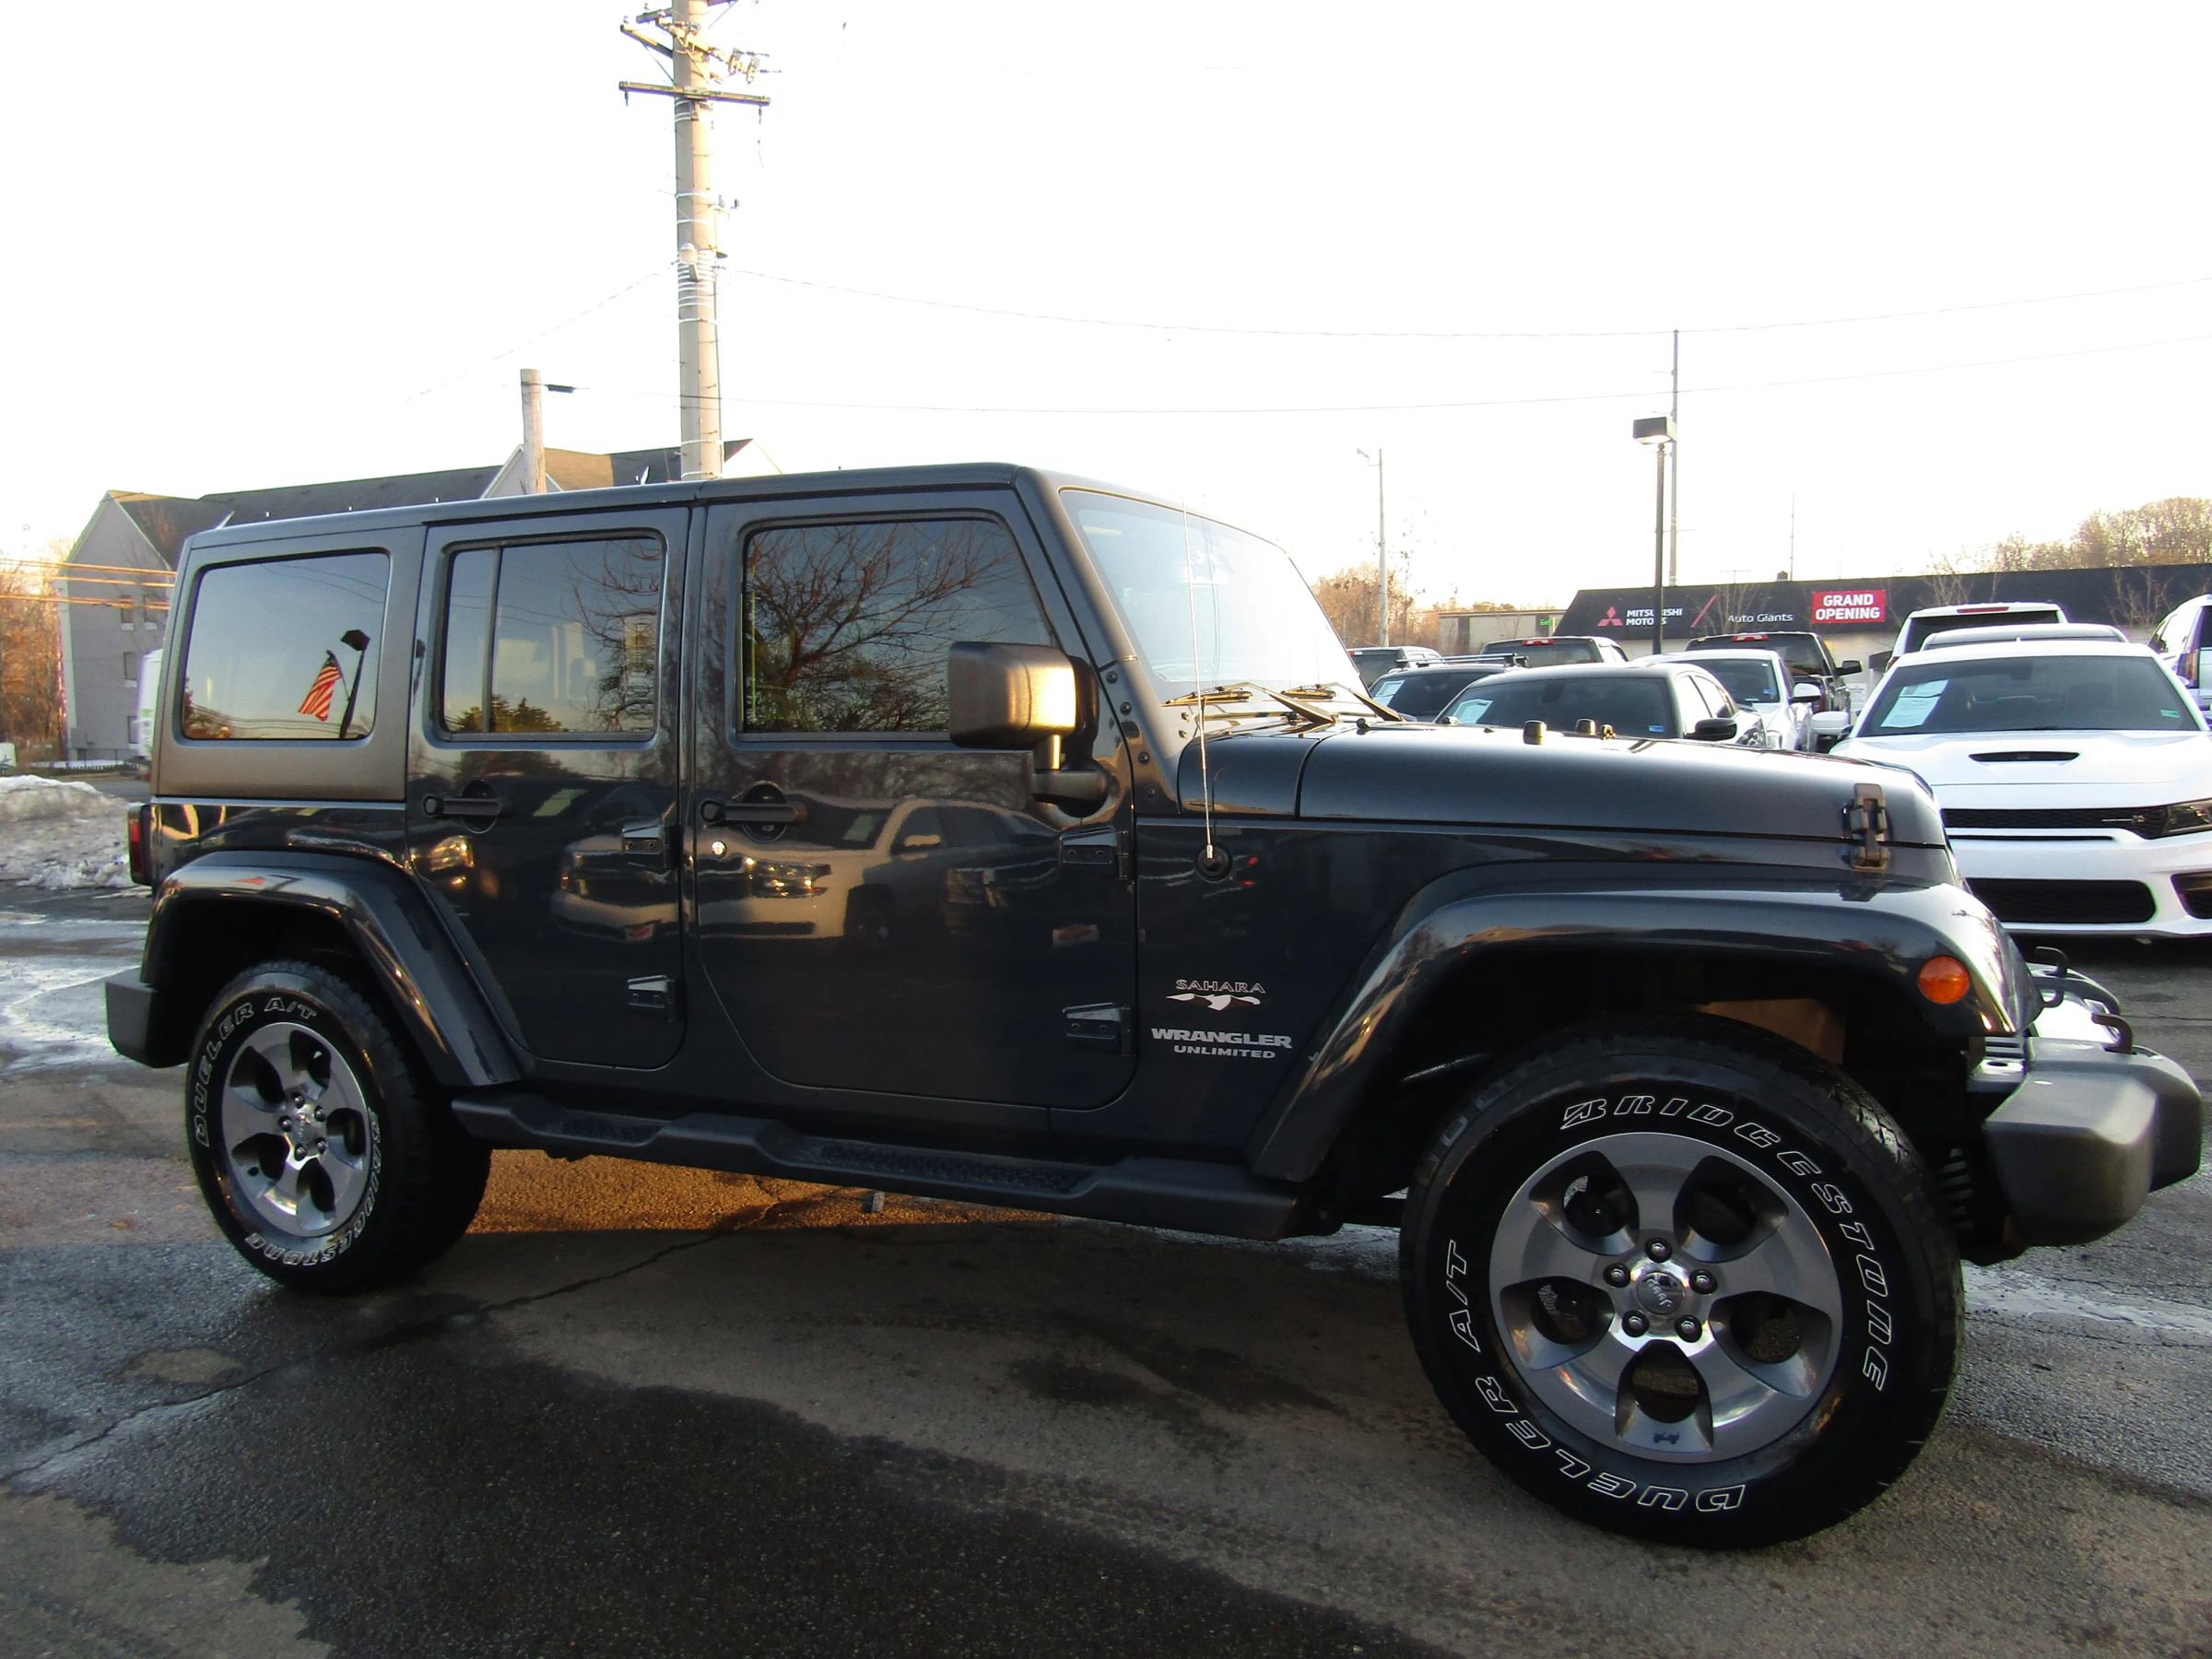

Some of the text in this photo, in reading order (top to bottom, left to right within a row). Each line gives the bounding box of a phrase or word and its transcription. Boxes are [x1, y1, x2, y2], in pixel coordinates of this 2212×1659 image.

[1823, 594, 1874, 606] GRAND
[1627, 608, 1683, 617] MITSISHI
[1728, 613, 1793, 623] Auto Giants
[1815, 607, 1881, 620] OPENING
[1626, 618, 1666, 626] MOTOS
[1176, 980, 1265, 994] SAHARA
[1151, 1029, 1292, 1049] WRANGLER
[1174, 1045, 1276, 1059] UNLIMITED
[194, 997, 317, 1147] DUELER A/T
[1561, 1095, 1893, 1391] BRIDGESTONE
[1446, 1240, 1481, 1352] A/T
[1475, 1377, 1746, 1512] DUELER
